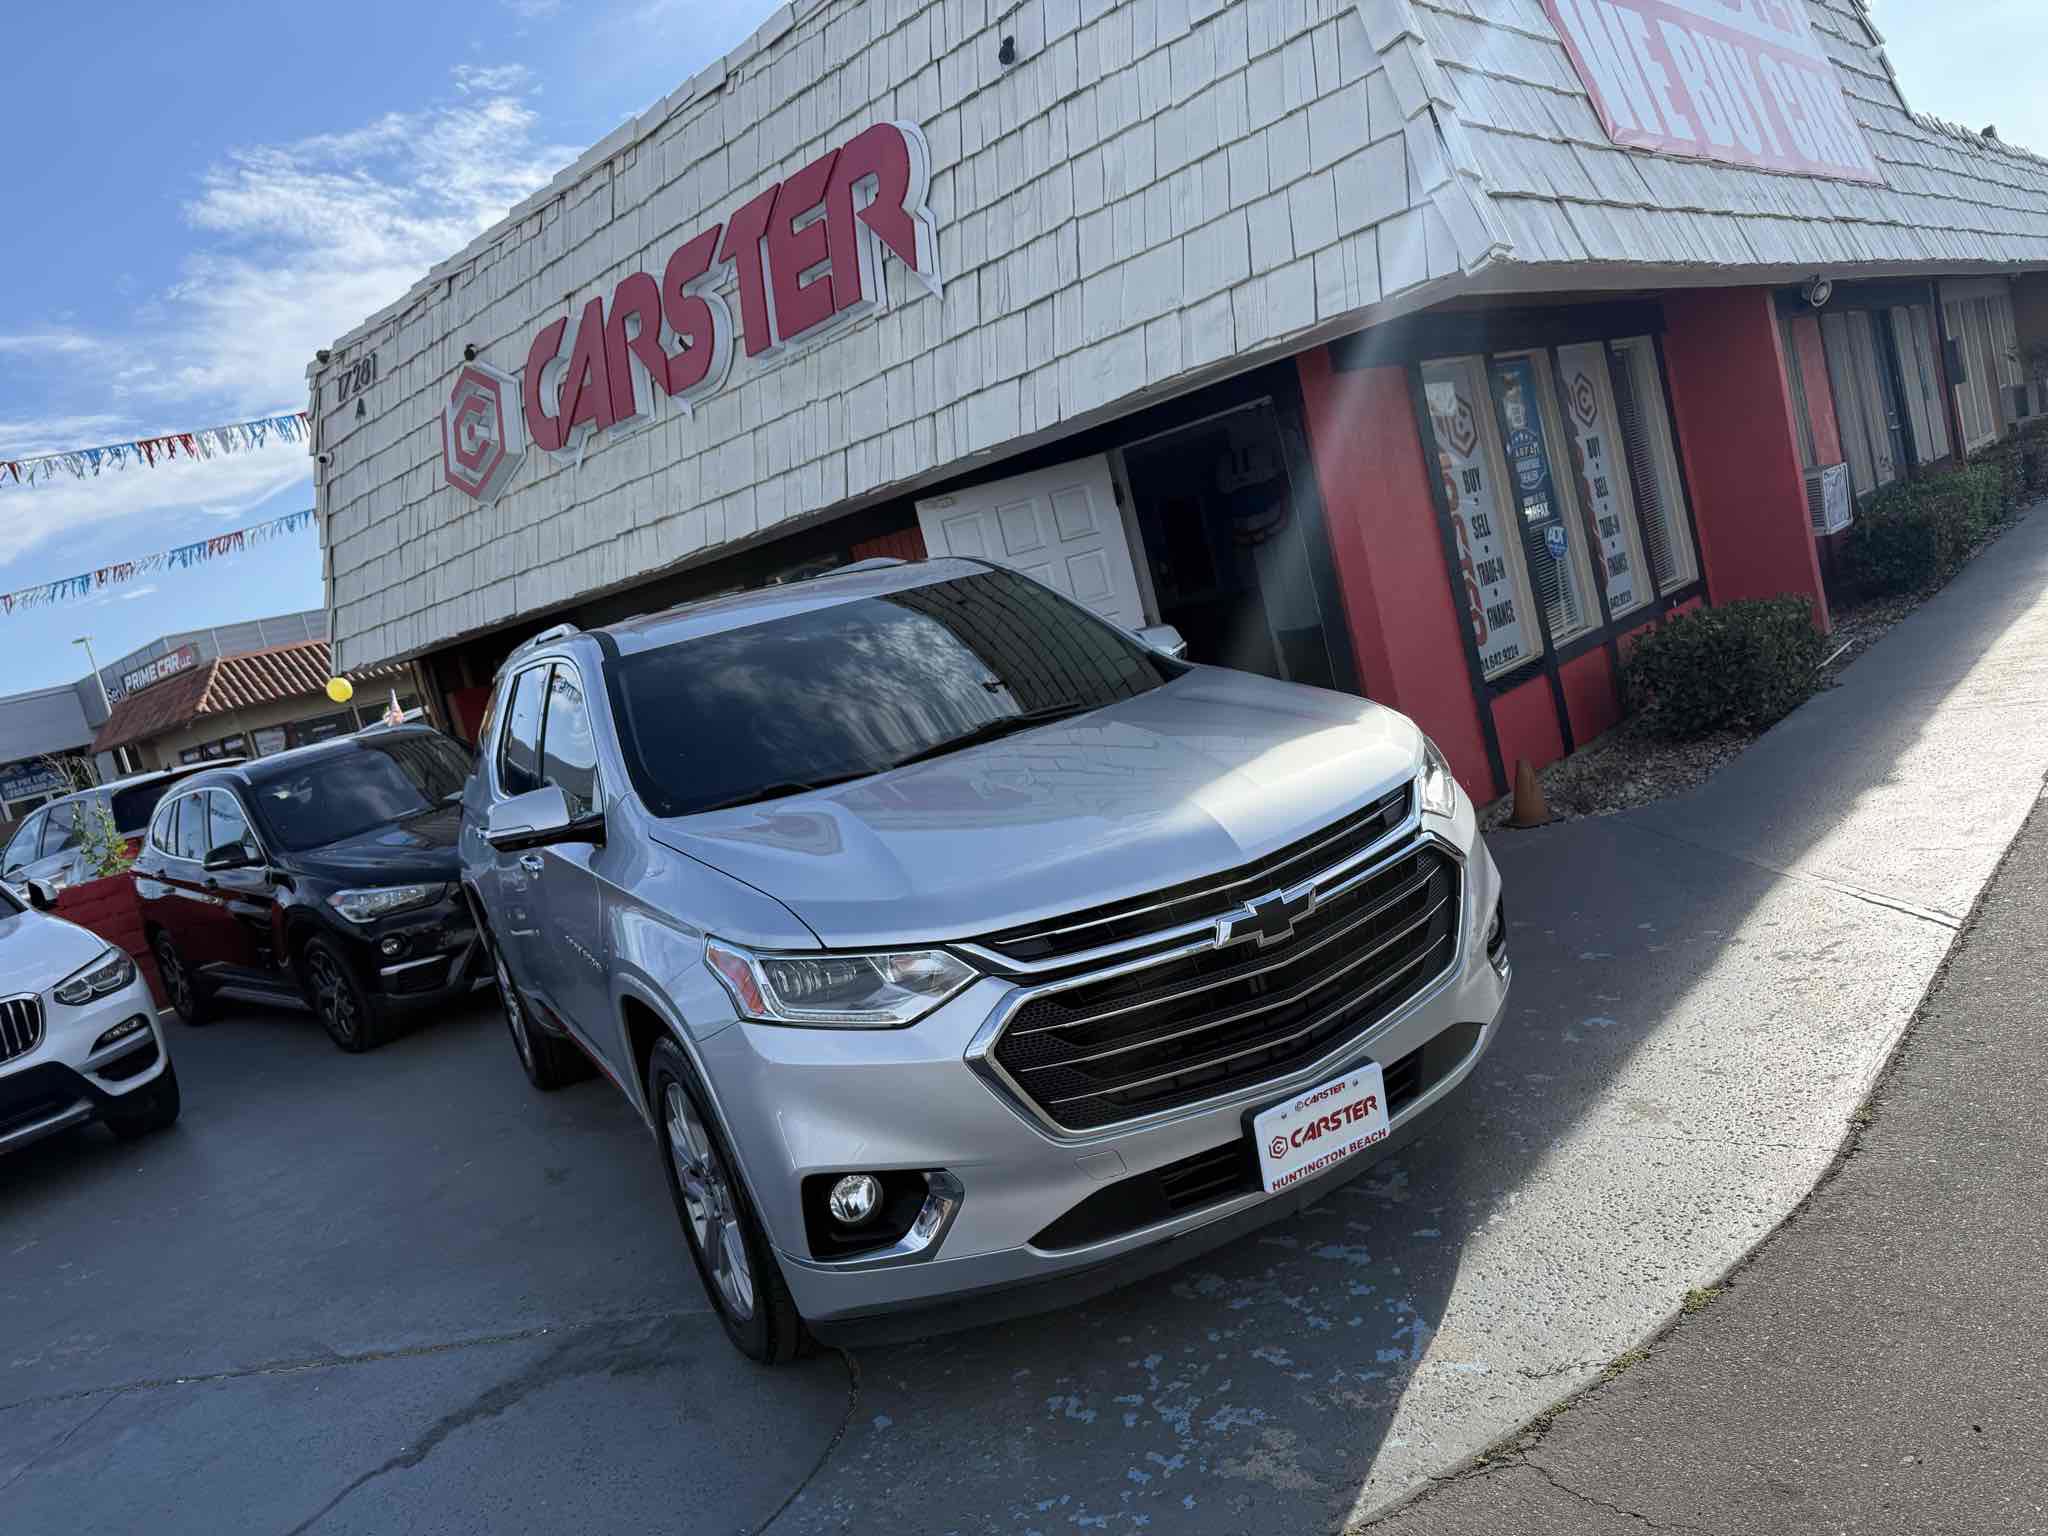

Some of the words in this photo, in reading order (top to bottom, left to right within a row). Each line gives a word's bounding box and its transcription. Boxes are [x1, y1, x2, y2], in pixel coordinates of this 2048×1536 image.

[1557, 0, 1697, 140] WE
[1657, 19, 1785, 156] BUY
[523, 122, 921, 453] CARSTER
[337, 352, 377, 402] 17281
[1462, 467, 1482, 494] BUY
[1471, 513, 1492, 540] SELL
[1476, 557, 1506, 587] TRADE-IN
[1486, 600, 1516, 632] FINANCE
[124, 663, 157, 691] PRIME
[157, 652, 180, 678] CAR
[1304, 1082, 1346, 1106] CARSTER
[1290, 1095, 1378, 1148] CARSTER
[1272, 1147, 1347, 1191] HUNTINGTON
[1349, 1128, 1387, 1153] BEACH
